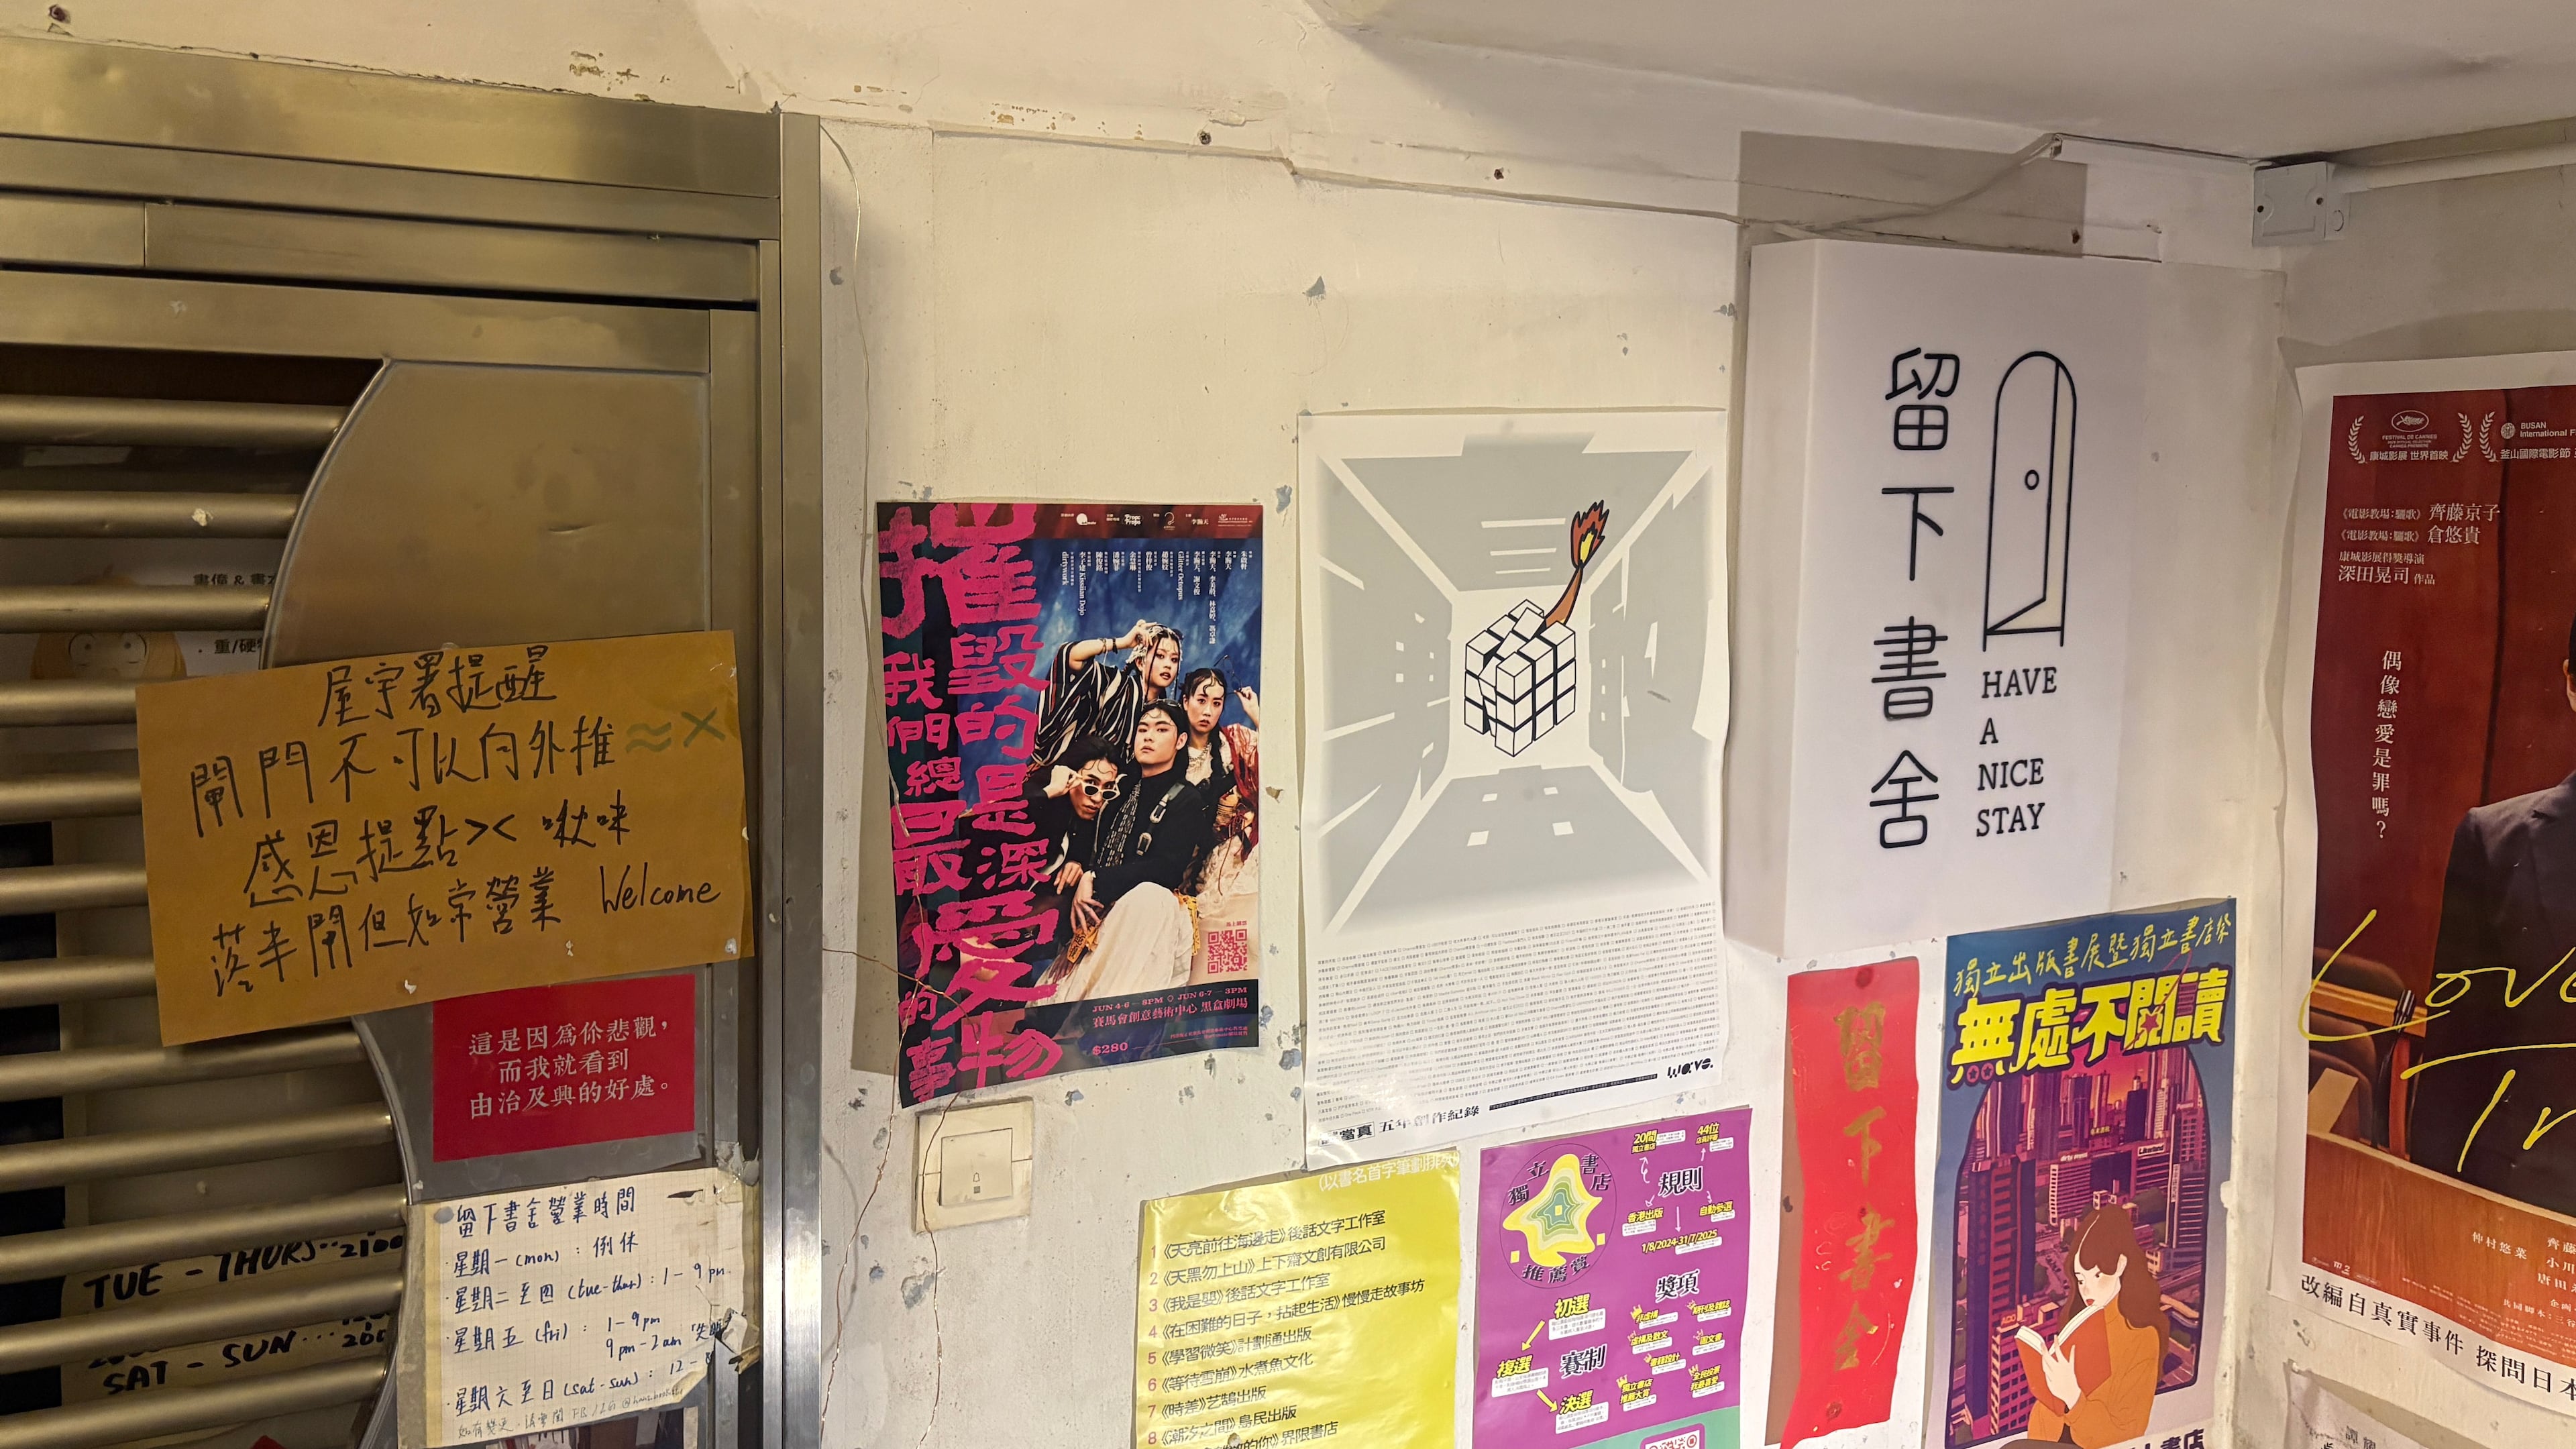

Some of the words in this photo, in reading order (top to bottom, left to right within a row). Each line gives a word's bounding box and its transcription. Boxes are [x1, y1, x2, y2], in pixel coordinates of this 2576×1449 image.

[2520, 429, 2567, 437] International
[2521, 421, 2546, 429] BUSAN
[2370, 451, 2408, 461] 康城影展
[2410, 450, 2448, 461] 世界首映
[2500, 447, 2571, 460] 釜山國際電影節
[2428, 503, 2500, 522] 齊藤京子
[2427, 525, 2481, 545] 倉悠貴
[2338, 565, 2409, 585] 深田晃司
[2414, 574, 2435, 585] 作品
[1870, 346, 1960, 849] 留下書舍
[319, 646, 556, 727] 屋宇署提醒
[1982, 666, 2057, 699] HAVE
[1980, 717, 1998, 746] A
[1978, 757, 2044, 791] NICE
[1976, 802, 2046, 838] STAY
[600, 861, 721, 913] Welcome
[1093, 1004, 1114, 1013] JUN
[1116, 1002, 1130, 1010] 4-6
[1142, 998, 1164, 1006] 8PM
[1177, 992, 1197, 1001] JUN
[1199, 989, 1213, 998] 6-7
[1093, 1003, 1197, 1028] 賽馬會創意藝術中心
[1201, 997, 1248, 1013] 黑盒劇場
[1951, 967, 2229, 1085] 無處不閱讀
[1092, 1042, 1128, 1056] $280
[499, 1049, 629, 1084] 而我就看到
[1379, 1105, 1480, 1133] 五年創作紀錄
[1697, 1122, 1719, 1135] 44位
[1633, 1129, 1658, 1144] 20間
[1658, 1166, 1703, 1197] 規則
[457, 1185, 636, 1238] 留下書舍營業時間
[1627, 1208, 1664, 1223] 香港出版
[454, 1248, 508, 1279] 星期一
[517, 1249, 559, 1269] (mon)
[594, 1231, 639, 1258] 例休
[1151, 1246, 1157, 1258] 1
[84, 1263, 163, 1309] TUE
[1150, 1272, 1158, 1285] 2
[1656, 1269, 1699, 1303] 獎項
[455, 1281, 554, 1315] 星期二至四
[1148, 1299, 1159, 1313] 3
[1554, 1292, 1591, 1320] 初選
[2301, 1274, 2464, 1355] 改編自真實事件
[454, 1324, 523, 1354] 星期五
[535, 1322, 569, 1345] (fri)
[1148, 1326, 1159, 1340] 4
[103, 1360, 168, 1395] SAT
[223, 1330, 297, 1368] SUN
[1148, 1352, 1157, 1364] 5
[1497, 1354, 1533, 1379] 複選
[1560, 1343, 1607, 1379] 賽制
[455, 1379, 554, 1417] 星期六至日
[1148, 1378, 1157, 1391] 6
[1147, 1405, 1156, 1419] 7
[1560, 1389, 1594, 1415] 決選
[1148, 1432, 1157, 1445] 8
